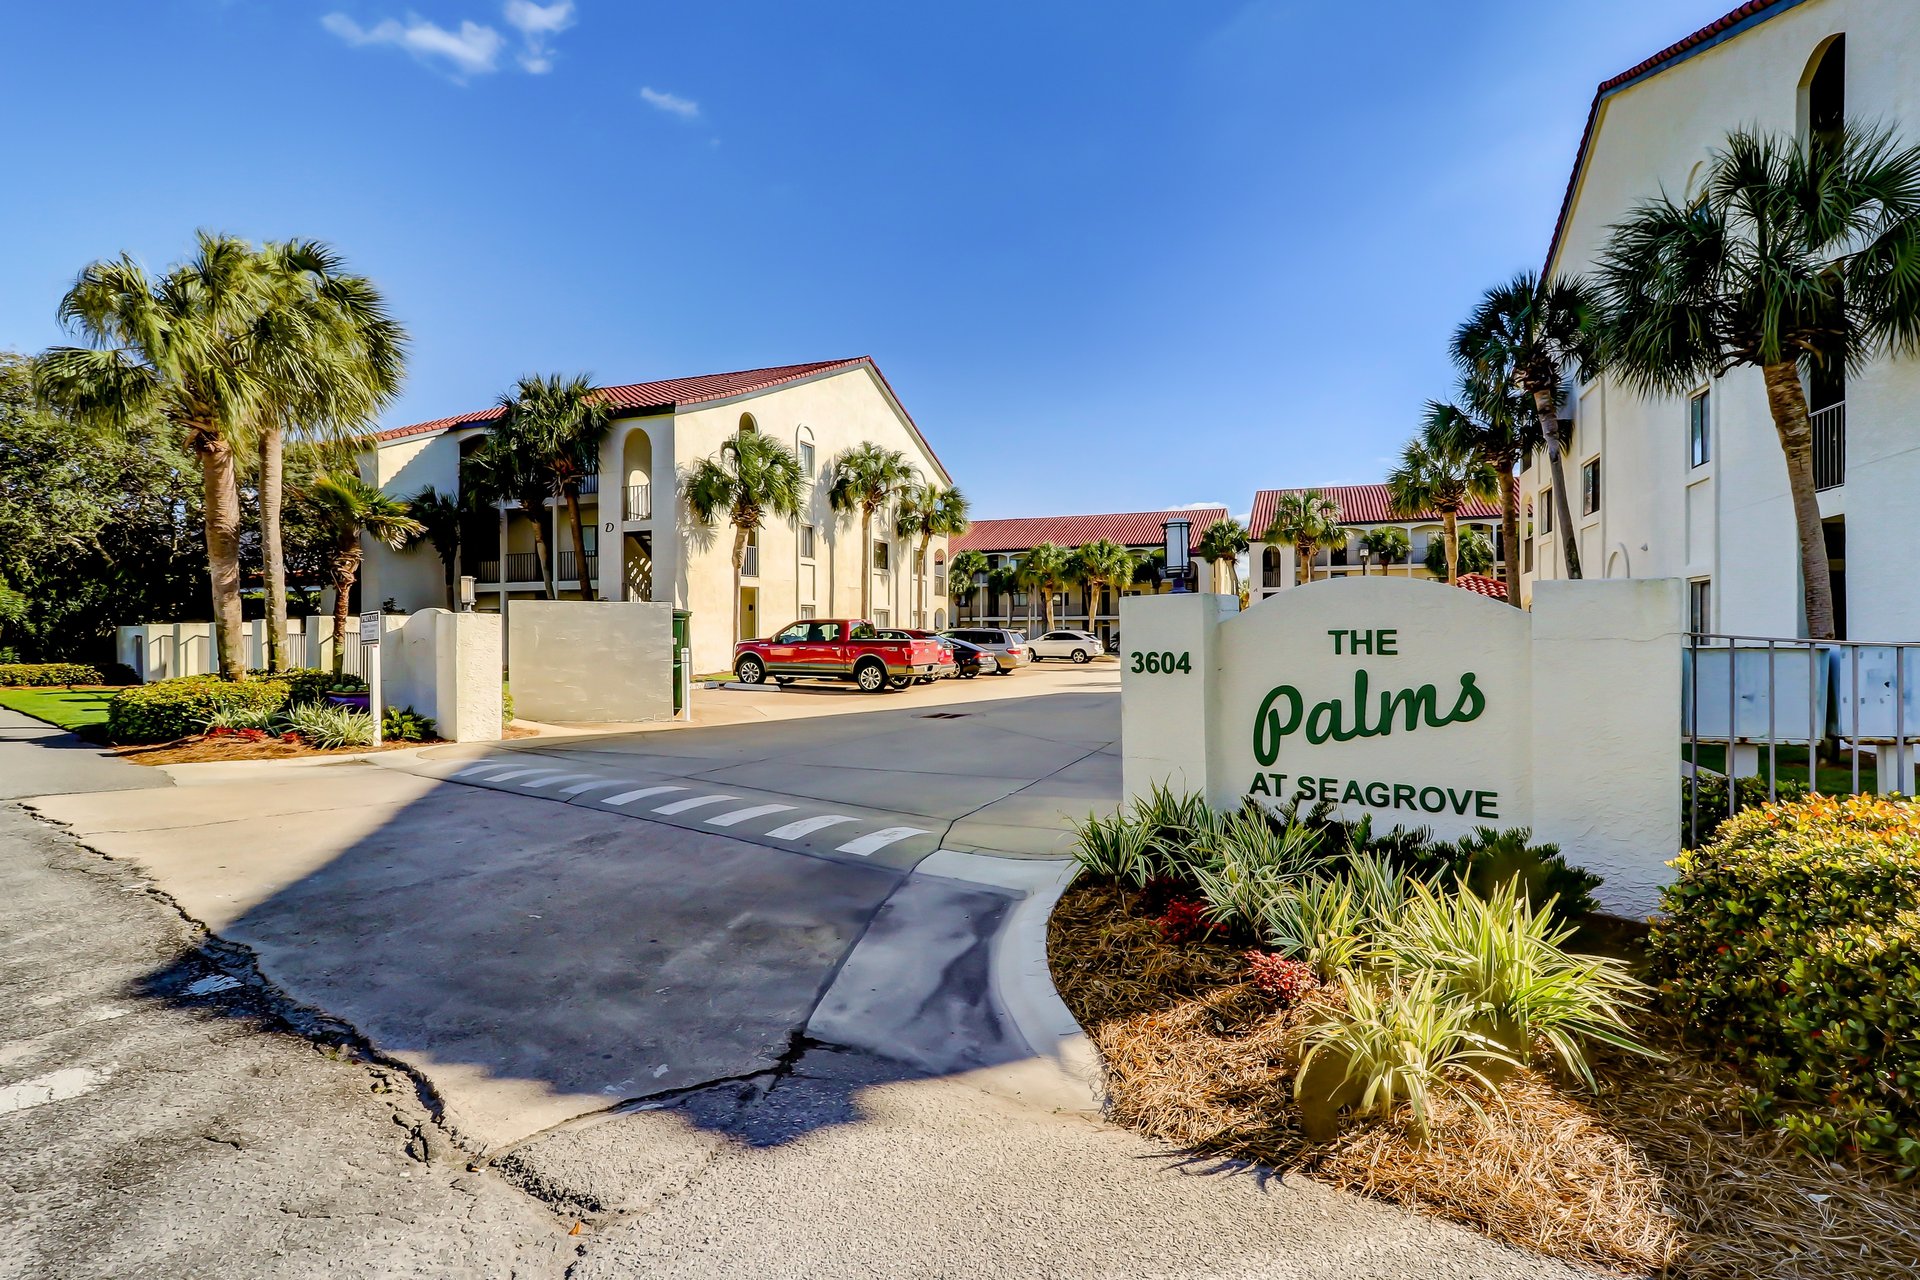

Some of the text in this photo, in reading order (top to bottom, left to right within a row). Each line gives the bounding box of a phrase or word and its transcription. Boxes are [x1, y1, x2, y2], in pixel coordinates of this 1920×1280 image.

[605, 522, 614, 532] D
[1328, 629, 1399, 656] THE
[1131, 651, 1192, 675] 3604
[1253, 669, 1486, 767] Palms
[1249, 772, 1500, 820] AT SEAGROVE
